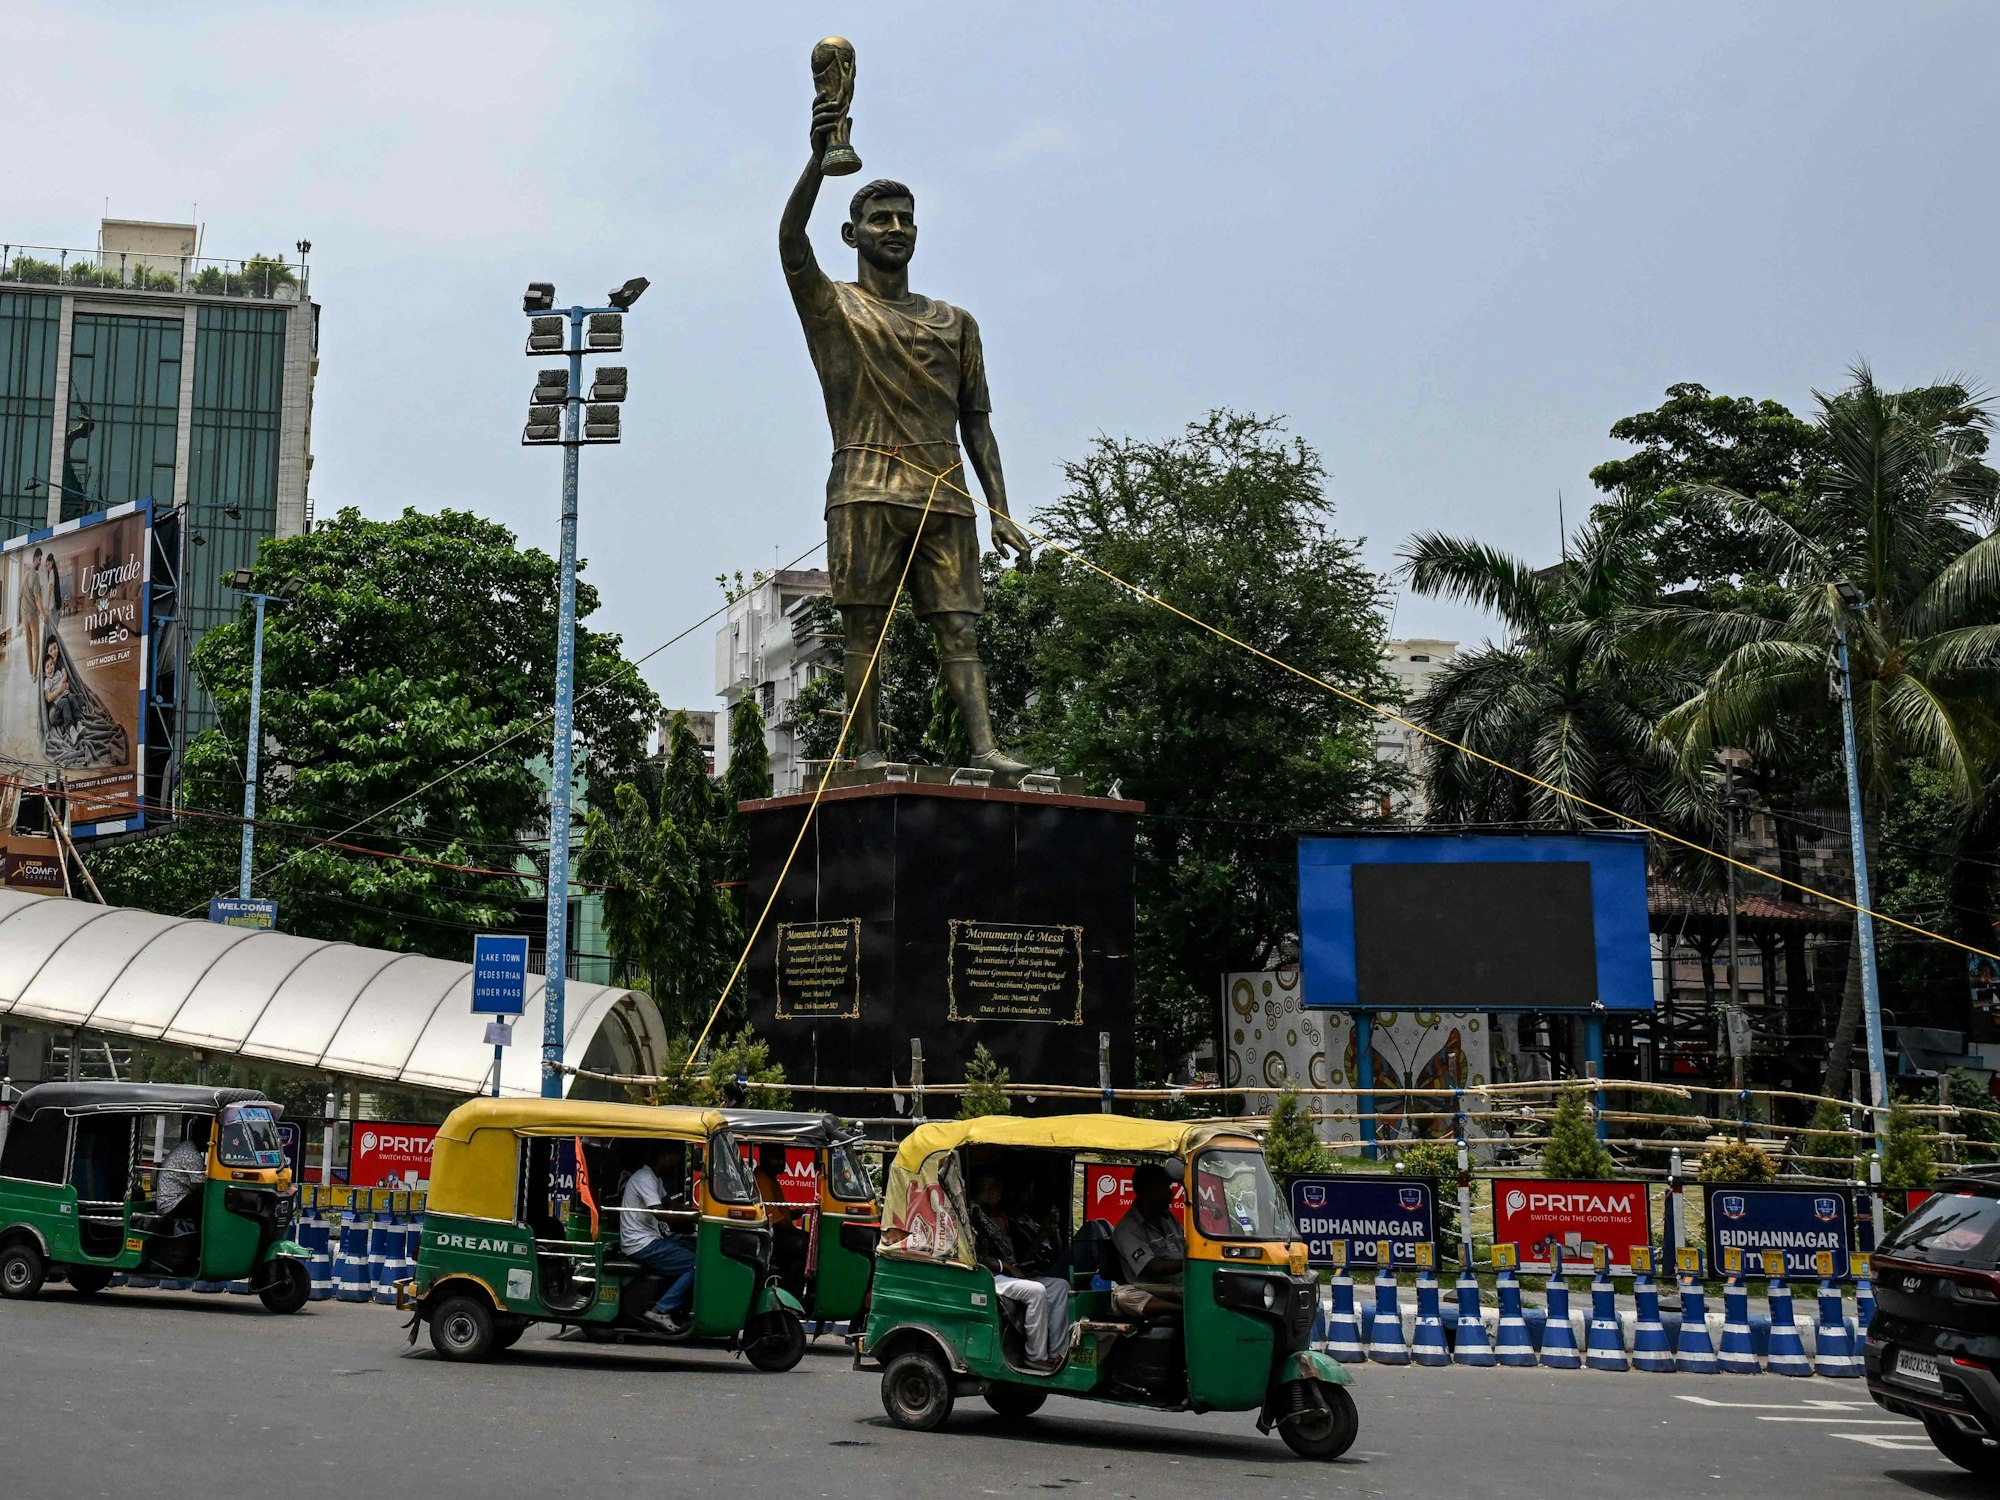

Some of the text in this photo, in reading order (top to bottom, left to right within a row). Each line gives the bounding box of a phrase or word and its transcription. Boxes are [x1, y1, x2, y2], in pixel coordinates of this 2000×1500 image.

[81, 553, 140, 599] Upgrade
[109, 588, 118, 598] to
[84, 603, 134, 632] morva
[90, 636, 108, 647] PHASE
[100, 654, 116, 664] MODEL
[118, 650, 130, 660] FLAT
[25, 866, 58, 876] COMFY
[217, 902, 272, 912] WELCOME
[830, 926, 848, 938] Messi
[965, 928, 1064, 942] Monumento de Messi
[480, 953, 520, 962] LAKE TOWN
[973, 956, 982, 964] An
[1008, 957, 1016, 968] of
[1017, 958, 1029, 966] Shri
[478, 970, 520, 980] PEDESTRIAN
[990, 969, 1022, 978] Government
[1024, 970, 1032, 980] of
[1032, 970, 1046, 978] West
[1046, 971, 1066, 980] Bengal
[969, 980, 995, 988] President
[1024, 982, 1048, 992] Sporting
[1048, 982, 1061, 990] Club
[476, 988, 520, 998] UNDER PASS
[996, 1005, 1010, 1013] 13th
[1010, 1006, 1038, 1014] December
[380, 1136, 435, 1154] PRITA
[1529, 1192, 1632, 1214] PRITAM
[937, 1211, 946, 1252] fortune
[1300, 1218, 1424, 1236] BIDHANNAGAR
[437, 1234, 508, 1252] DREAM
[1720, 1230, 1840, 1248] BIDHANNAGAR
[1310, 1240, 1334, 1256] CIT
[1354, 1240, 1416, 1258] POCE
[1787, 1253, 1818, 1270] OLIC
